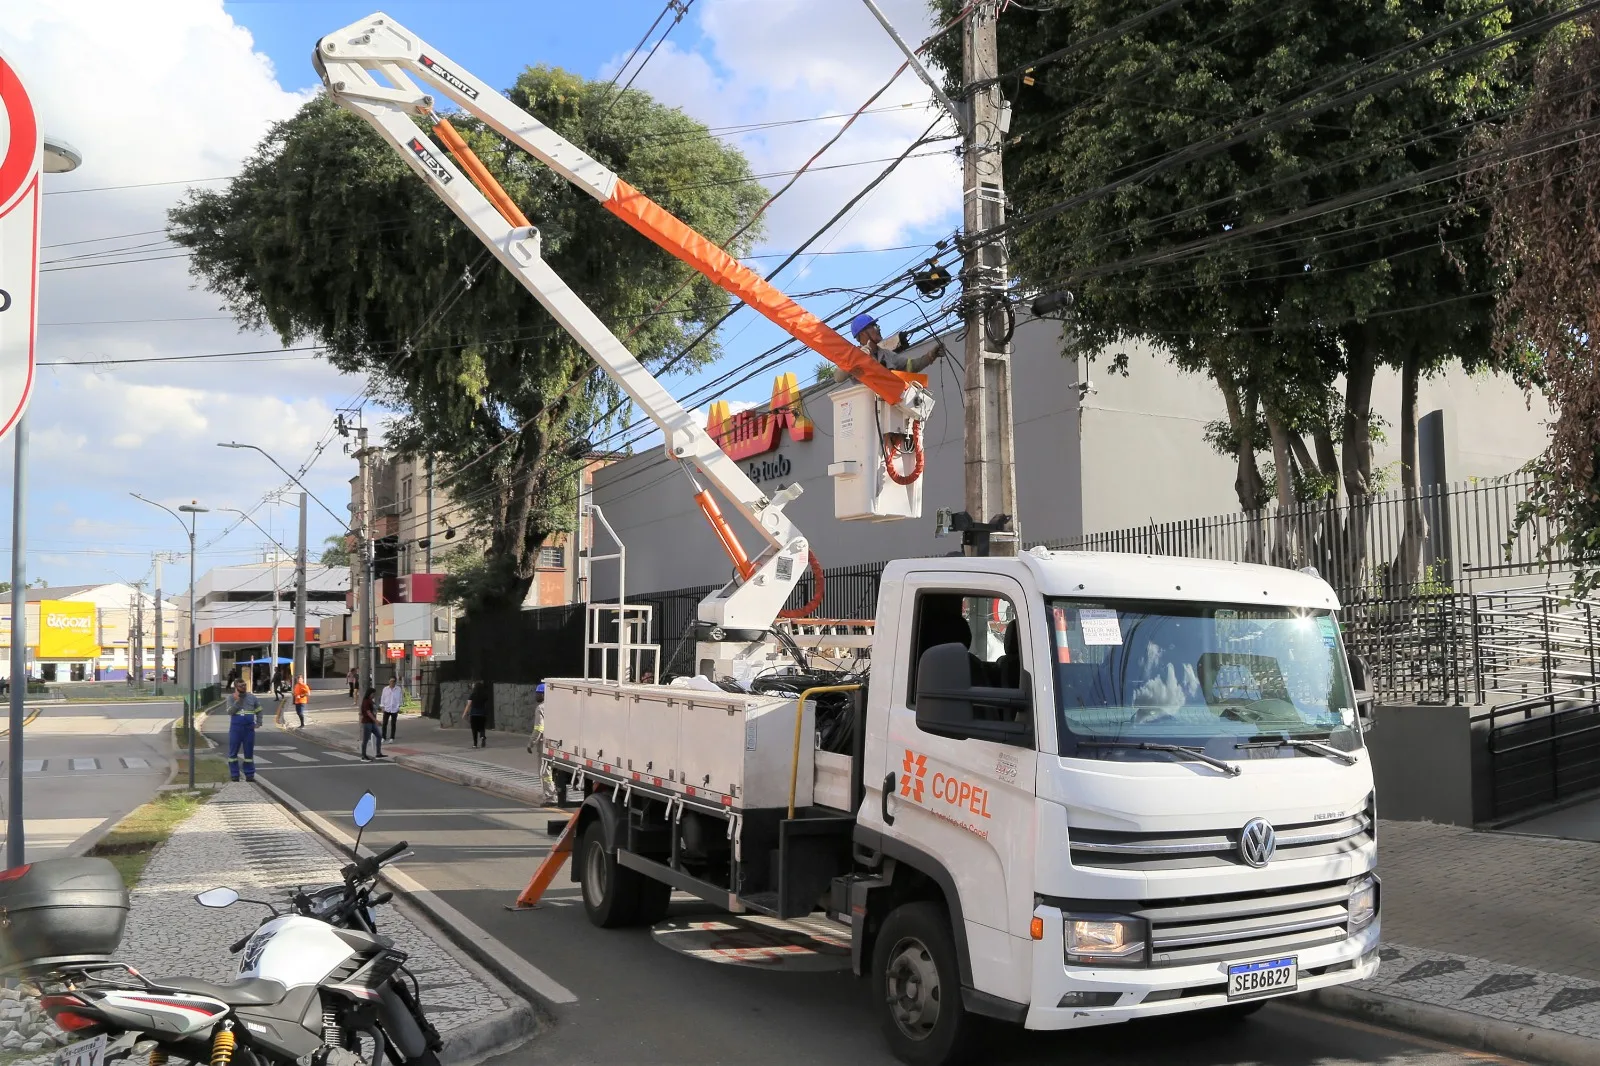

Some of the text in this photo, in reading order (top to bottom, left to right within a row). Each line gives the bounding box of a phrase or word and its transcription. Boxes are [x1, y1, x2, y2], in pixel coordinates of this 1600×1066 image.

[430, 62, 478, 98] SKYRITZ
[419, 150, 452, 183] NEXT
[763, 454, 791, 481] tudo
[932, 772, 992, 819] COPEL
[968, 824, 989, 840] Copel
[1235, 967, 1290, 992] SEB6B29
